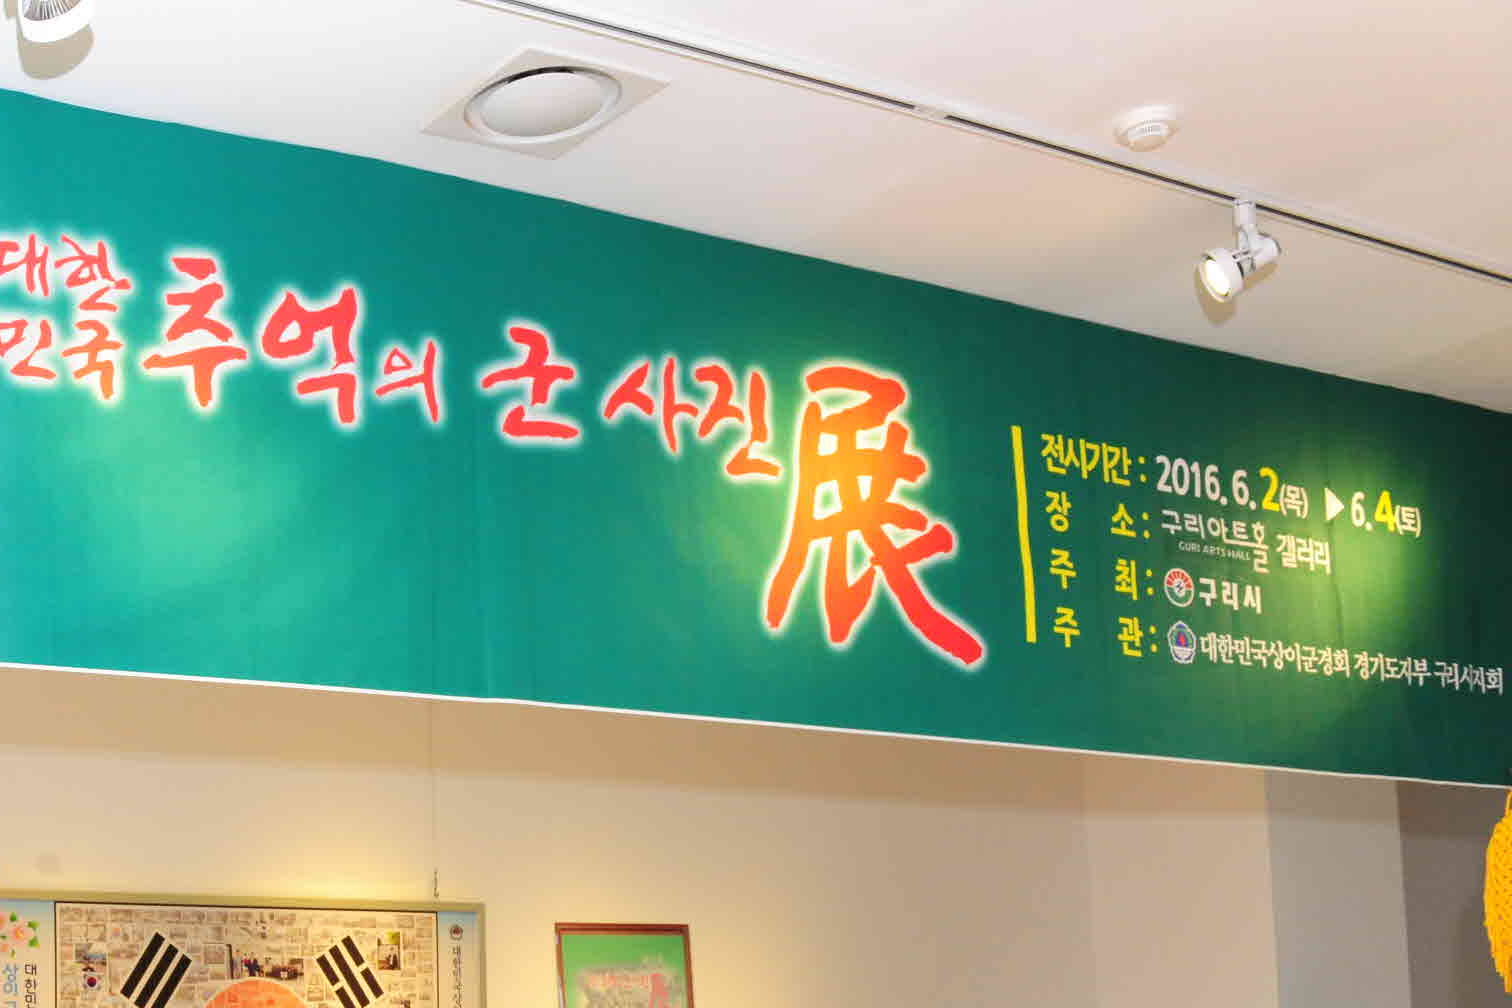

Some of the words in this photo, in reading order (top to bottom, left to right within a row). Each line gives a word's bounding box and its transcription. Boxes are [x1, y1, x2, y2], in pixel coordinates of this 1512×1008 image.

[142, 254, 439, 425] 추억의
[1160, 508, 1271, 574] 구리아트홀
[1274, 532, 1332, 576] 갤러리
[1198, 576, 1263, 615] 구리시
[1199, 630, 1351, 679] 대한민국상이군경회
[1353, 649, 1432, 687] 경기도지부
[1434, 659, 1504, 696] 구리시지회
